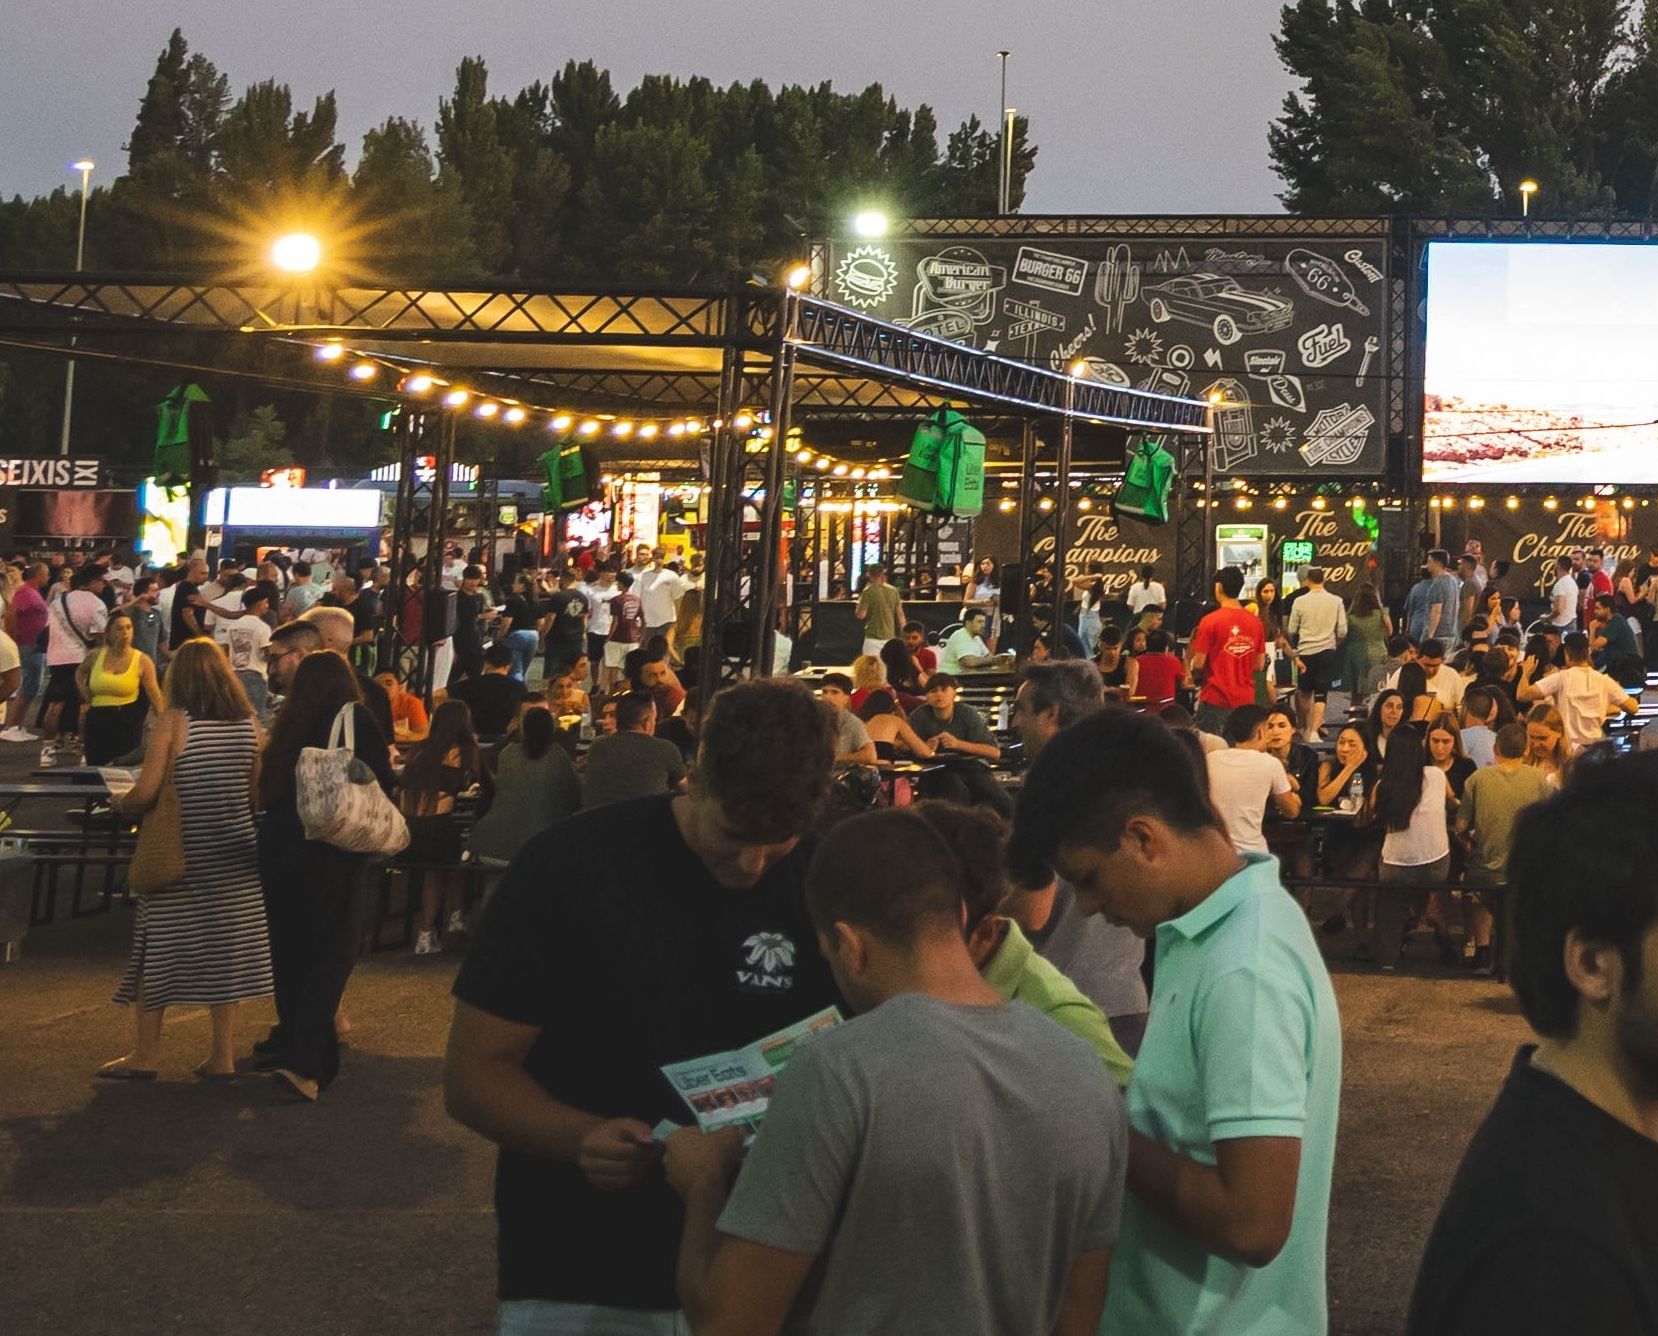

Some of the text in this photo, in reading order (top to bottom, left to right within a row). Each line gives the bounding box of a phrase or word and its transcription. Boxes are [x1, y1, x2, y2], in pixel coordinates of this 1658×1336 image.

[929, 261, 990, 277] American
[1019, 257, 1063, 281] BURGER
[1064, 268, 1083, 285] 66
[1307, 267, 1332, 290] 66
[1344, 250, 1384, 284] Custom
[944, 275, 990, 292] Burger
[922, 320, 966, 336] OTEL
[1013, 305, 1059, 327] ILLINOIS
[1300, 325, 1349, 365] Fuel
[1074, 514, 1119, 546] The
[1295, 510, 1339, 540] The
[1557, 512, 1598, 543] The
[1033, 535, 1161, 564] ampions
[1513, 533, 1641, 563] Chamons
[1064, 564, 1138, 595] Bger
[675, 1071, 711, 1091] Uber
[710, 1064, 747, 1083] Eats
